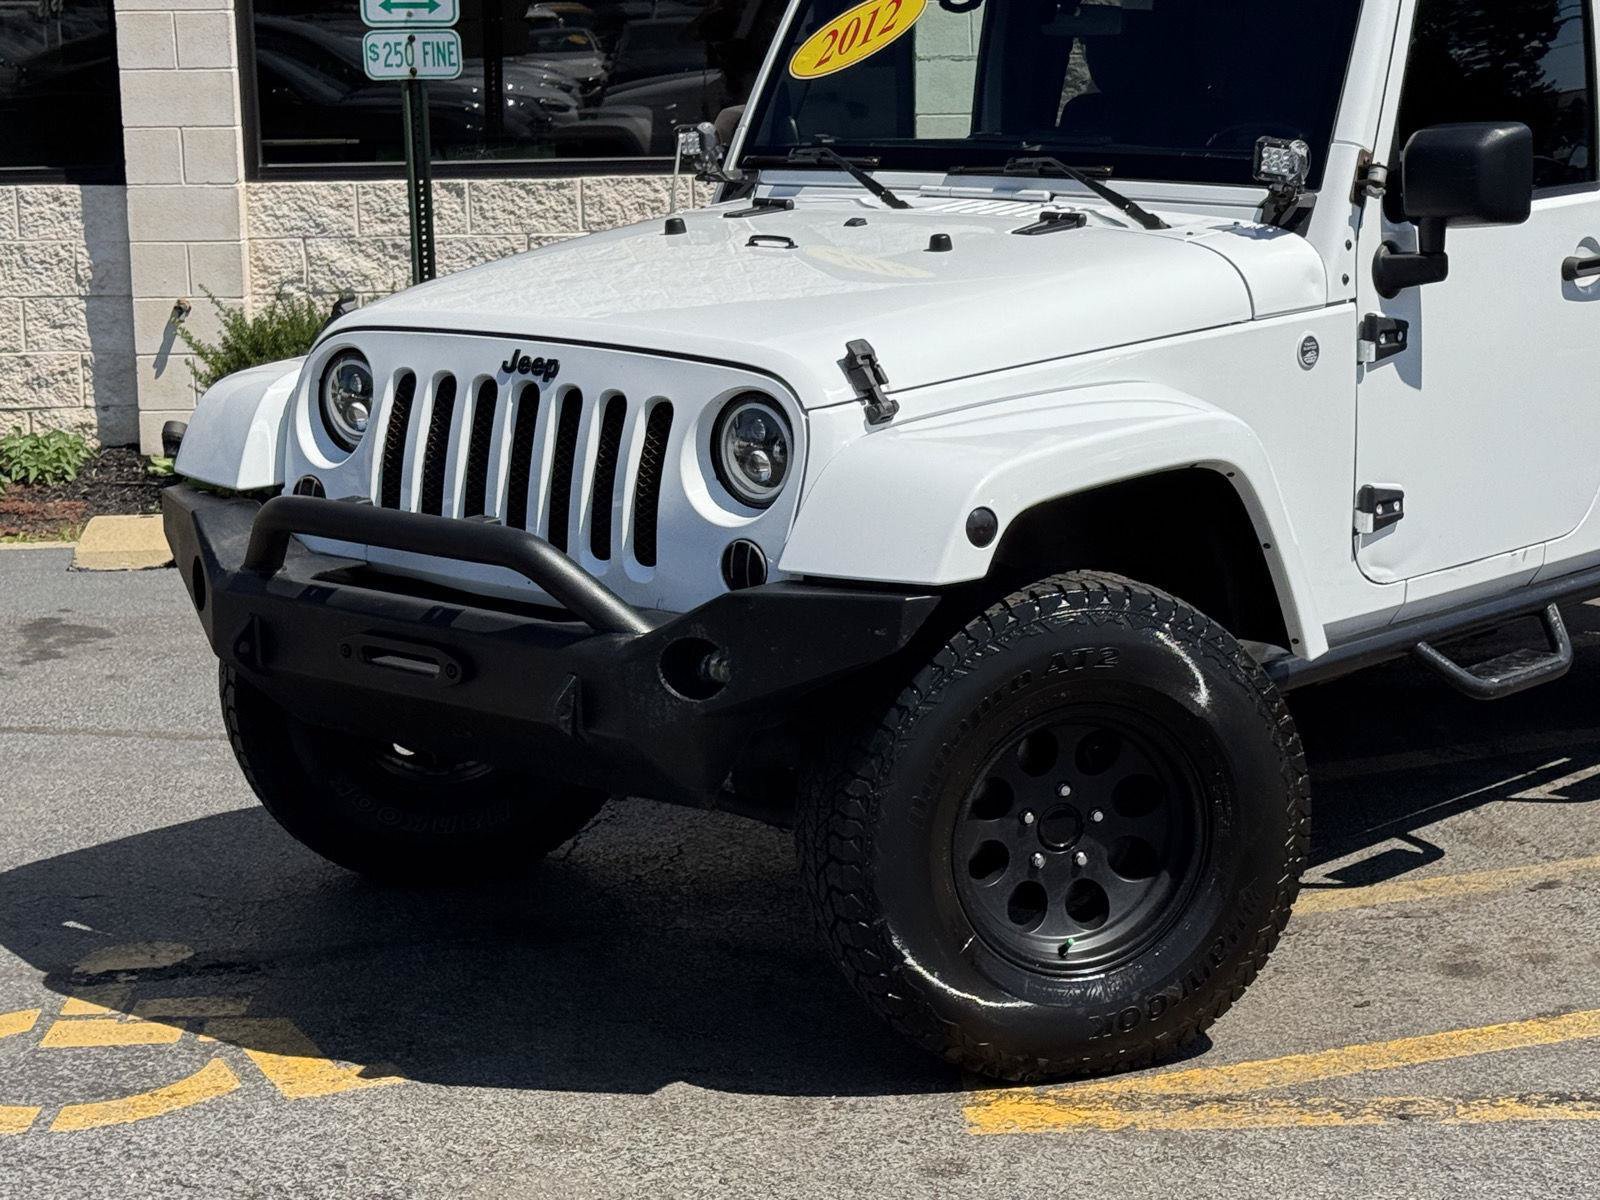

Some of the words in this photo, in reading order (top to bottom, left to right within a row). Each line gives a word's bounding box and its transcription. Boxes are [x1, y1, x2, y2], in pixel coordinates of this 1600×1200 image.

[813, 0, 902, 69] 2012
[368, 41, 415, 68] $250
[422, 41, 458, 68] FINE
[501, 348, 560, 383] Jeep
